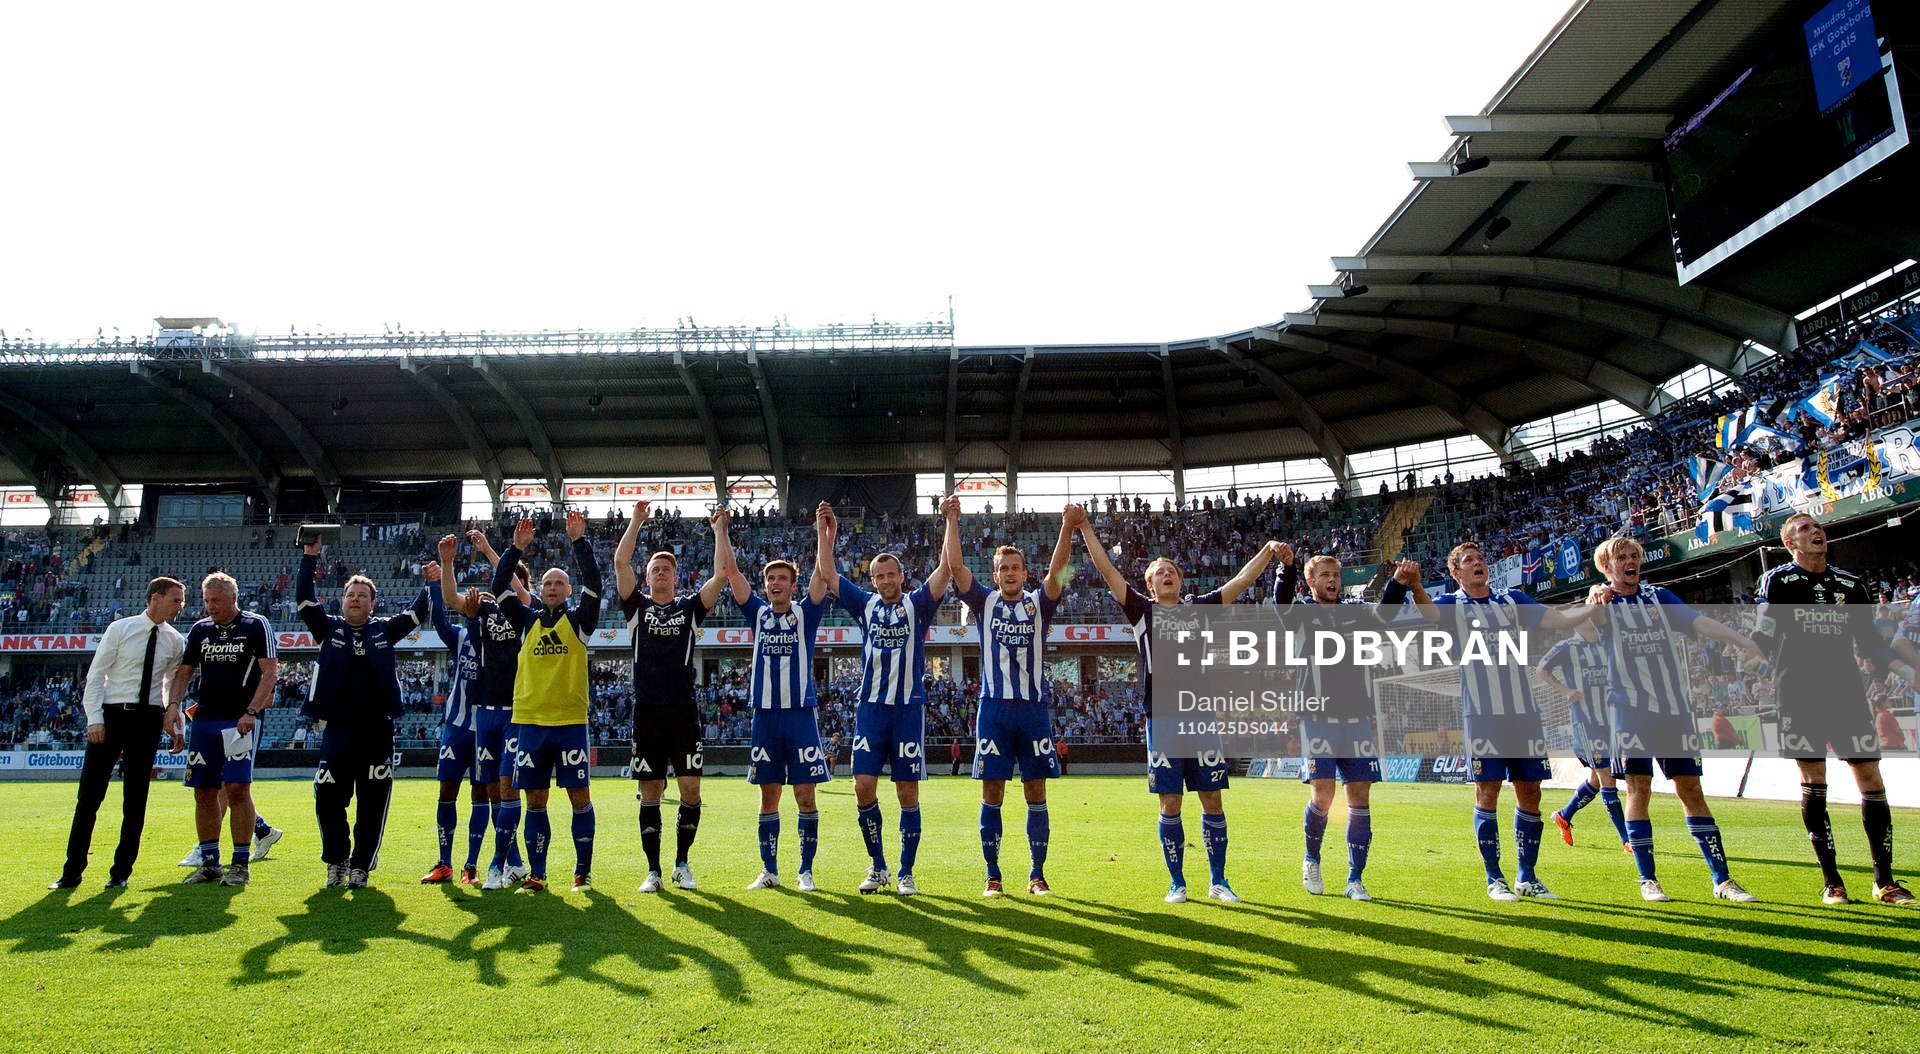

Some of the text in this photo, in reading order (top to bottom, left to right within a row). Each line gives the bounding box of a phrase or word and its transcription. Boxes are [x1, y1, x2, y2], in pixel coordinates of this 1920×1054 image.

[1809, 39, 1826, 58] IFK
[1833, 32, 1857, 55] GAIS
[507, 487, 534, 497] GT
[567, 486, 595, 496] GT
[619, 486, 646, 495] GT
[670, 485, 698, 495] GT
[959, 481, 986, 491] GT
[8, 494, 34, 503] GT
[1153, 615, 1200, 631] Prioritet
[1794, 608, 1850, 624] Prioritet
[648, 625, 680, 636] Finans
[869, 622, 910, 637] Prioritet
[1065, 626, 1112, 641] GT
[1803, 621, 1841, 635] Finans
[0, 636, 87, 650] NKTAN
[760, 631, 798, 644] Prioritet
[872, 636, 904, 648] Finans
[996, 631, 1030, 645] Finans
[200, 642, 244, 654] Prioritet
[533, 641, 569, 656] adidas
[204, 653, 237, 662] Finans
[505, 738, 518, 753] IC
[853, 735, 871, 752] CA
[899, 741, 922, 758] ICA
[1032, 737, 1056, 757] ICA
[1682, 734, 1699, 751] IC
[1780, 733, 1815, 753] ICA
[188, 751, 206, 766] CA
[440, 745, 456, 760] CA
[518, 750, 535, 768] CA
[562, 748, 588, 766] ICA
[751, 746, 771, 762] CA
[798, 746, 825, 763] ICA
[1197, 749, 1226, 767] ICA
[28, 753, 84, 769] Göteborg
[686, 754, 703, 770] IC
[909, 762, 921, 774] 14
[1048, 758, 1055, 769] 3
[1369, 761, 1378, 772] 11
[577, 769, 586, 779] 8
[809, 765, 825, 777] 28
[1210, 770, 1225, 783] 27
[1164, 837, 1179, 863] SKF
[1706, 835, 1724, 862] SKF
